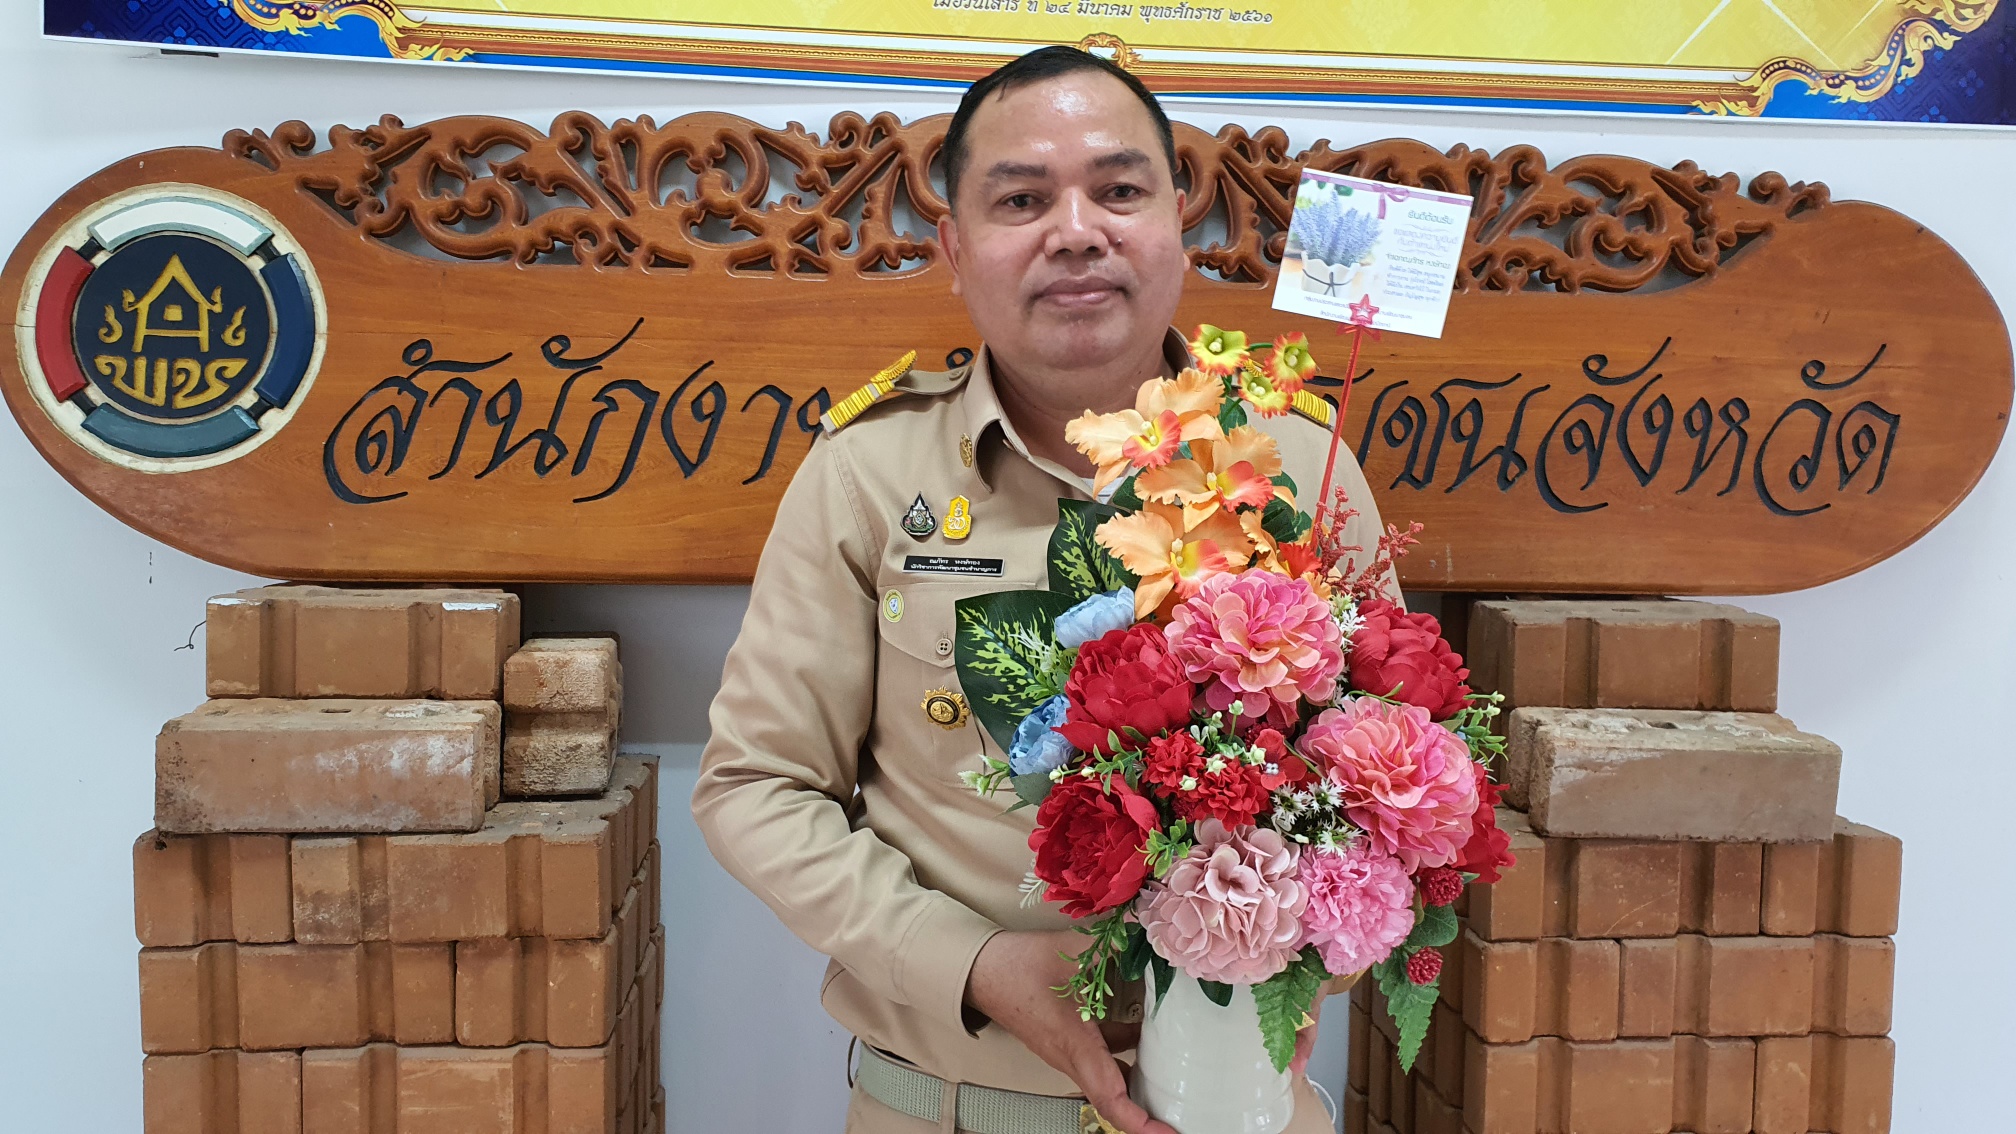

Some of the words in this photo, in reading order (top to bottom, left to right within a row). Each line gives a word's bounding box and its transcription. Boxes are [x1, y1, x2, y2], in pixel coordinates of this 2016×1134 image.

[1077, 0, 1133, 17] มนาคม
[1139, 1, 1224, 23] พุทธศักราช
[1229, 8, 1273, 23] ๒๕๖๑
